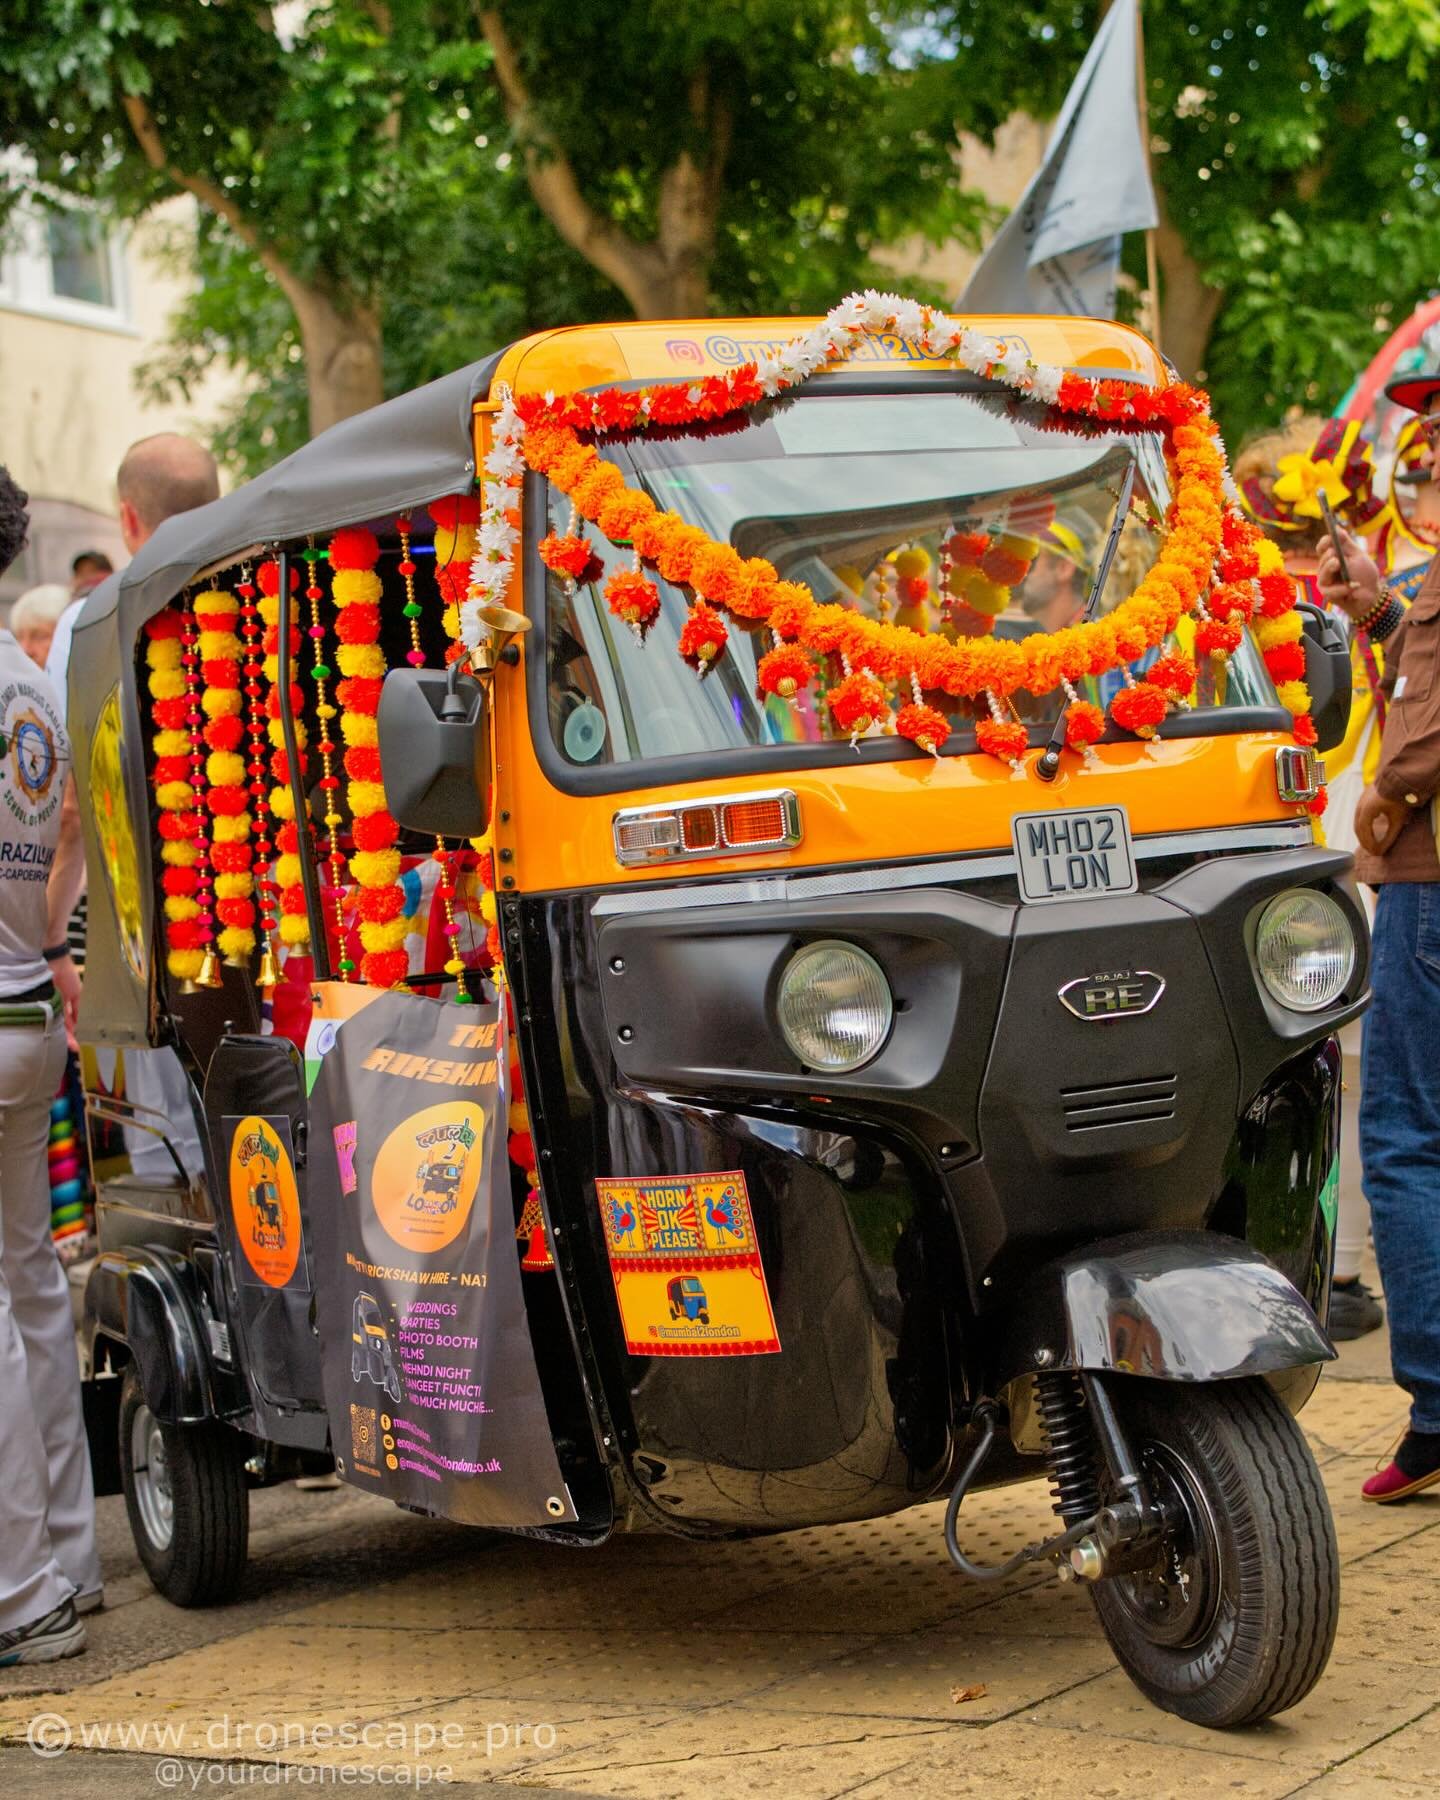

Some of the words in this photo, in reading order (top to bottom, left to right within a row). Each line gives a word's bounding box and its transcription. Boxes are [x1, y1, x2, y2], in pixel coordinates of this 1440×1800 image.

[1026, 815, 1117, 857] MH02
[1042, 852, 1111, 892] LON
[1094, 972, 1131, 983] BAJAJ
[1085, 982, 1145, 1013] RE
[448, 1023, 498, 1048] THE
[645, 1188, 687, 1208] HORN
[657, 1208, 682, 1231] OK
[650, 1231, 698, 1249] PLEASE
[367, 1264, 430, 1285] RICKSHAW
[430, 1271, 450, 1285] HIRE
[406, 1302, 457, 1316] WEDDINGS
[400, 1316, 440, 1330] PARTIES
[399, 1331, 434, 1345] PHOTO
[436, 1334, 478, 1349] BOOTH
[400, 1346, 425, 1360] FILMS
[435, 1365, 471, 1380] NIGHT
[420, 1394, 446, 1410] MUCH
